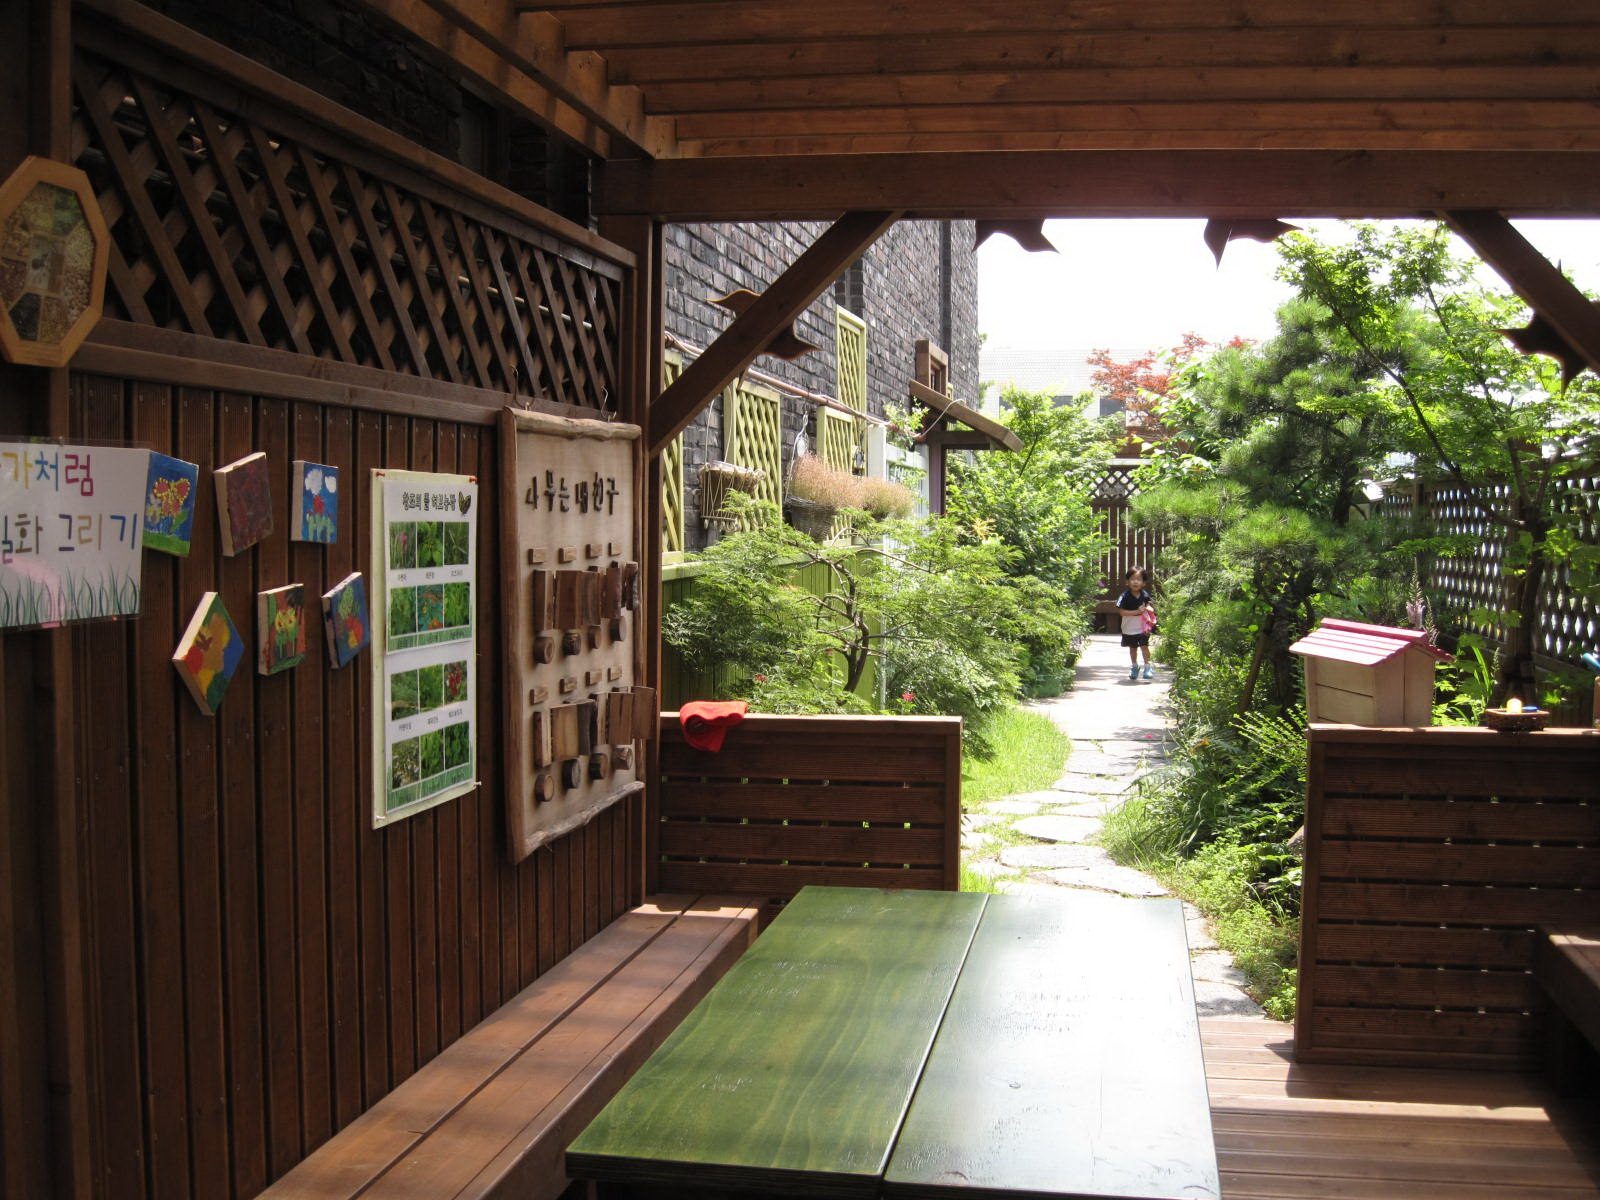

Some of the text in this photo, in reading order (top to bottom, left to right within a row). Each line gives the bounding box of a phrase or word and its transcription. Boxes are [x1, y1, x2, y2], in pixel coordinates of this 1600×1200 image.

[525, 469, 570, 513] 나무는
[593, 471, 620, 516] 친구
[58, 512, 138, 552] 그리기
